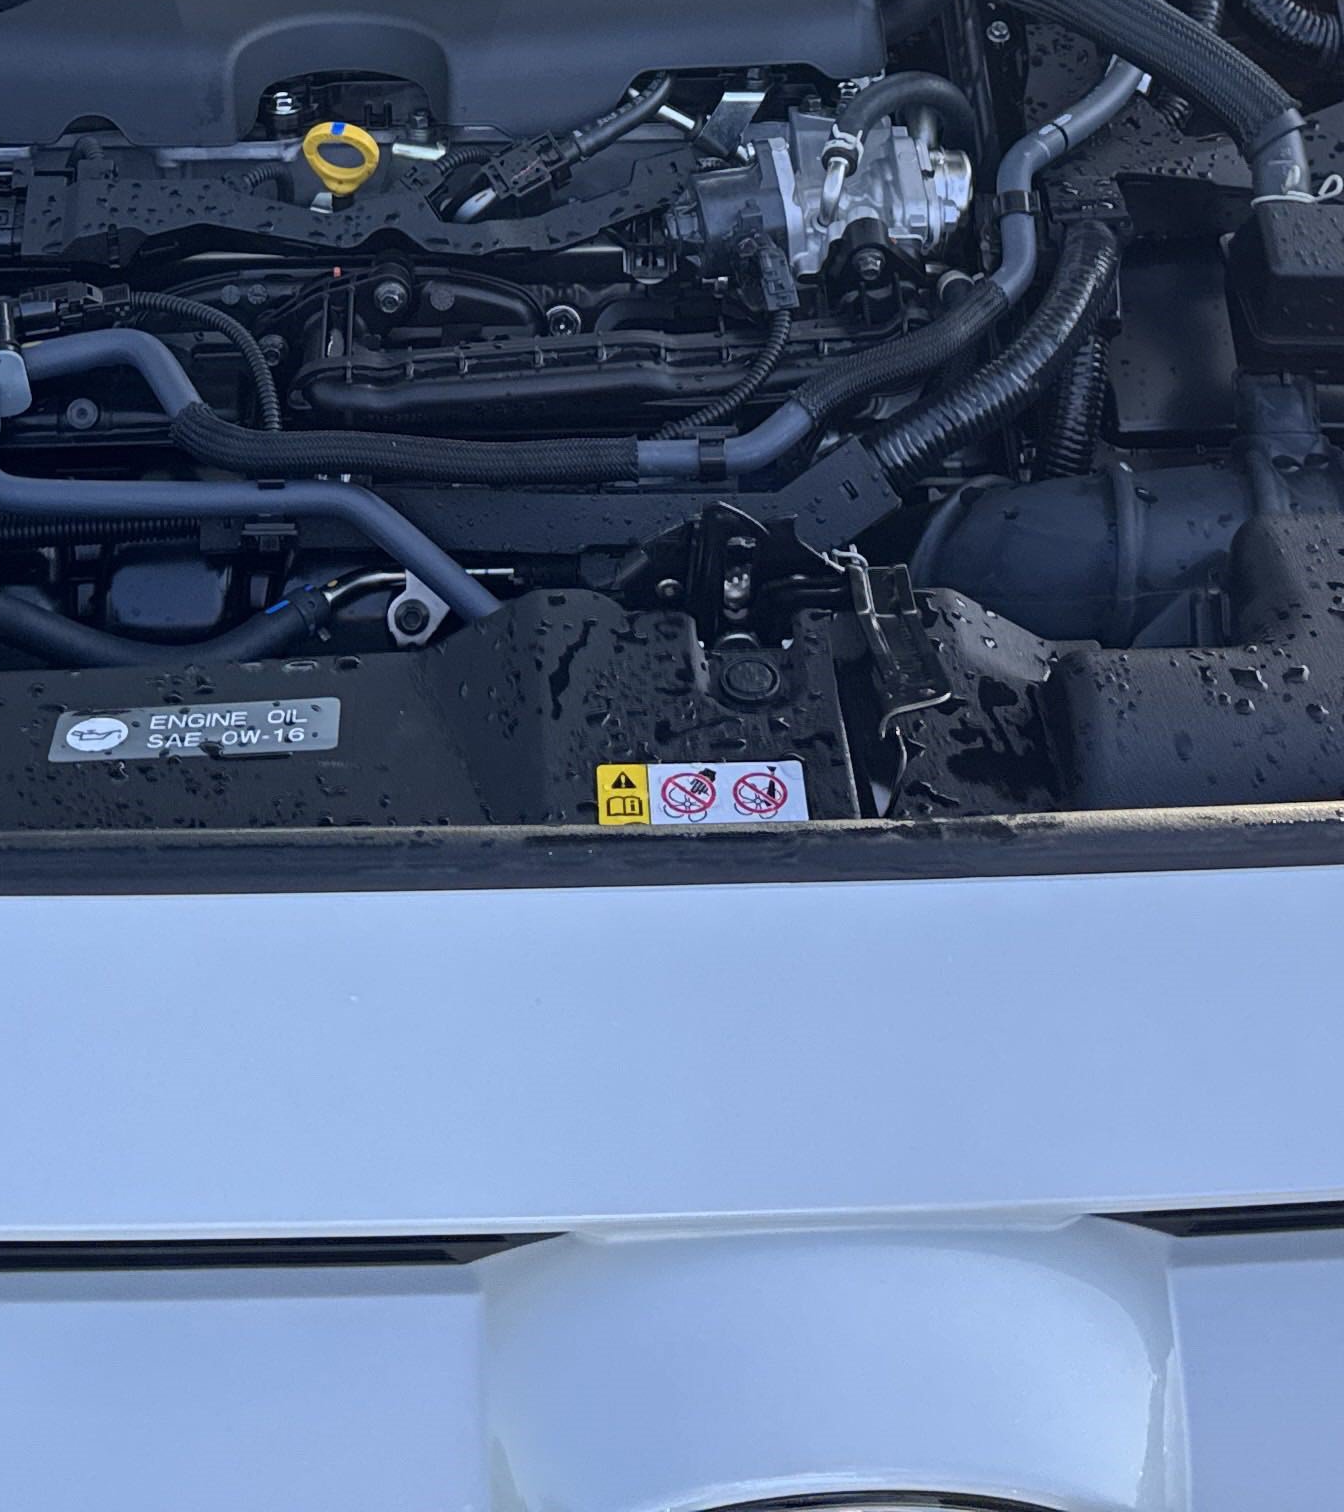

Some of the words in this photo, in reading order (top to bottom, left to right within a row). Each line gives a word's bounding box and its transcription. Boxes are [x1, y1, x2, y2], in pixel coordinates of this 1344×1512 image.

[149, 711, 248, 730] ENGINE
[267, 709, 308, 725] OIL
[146, 734, 201, 749] SAE
